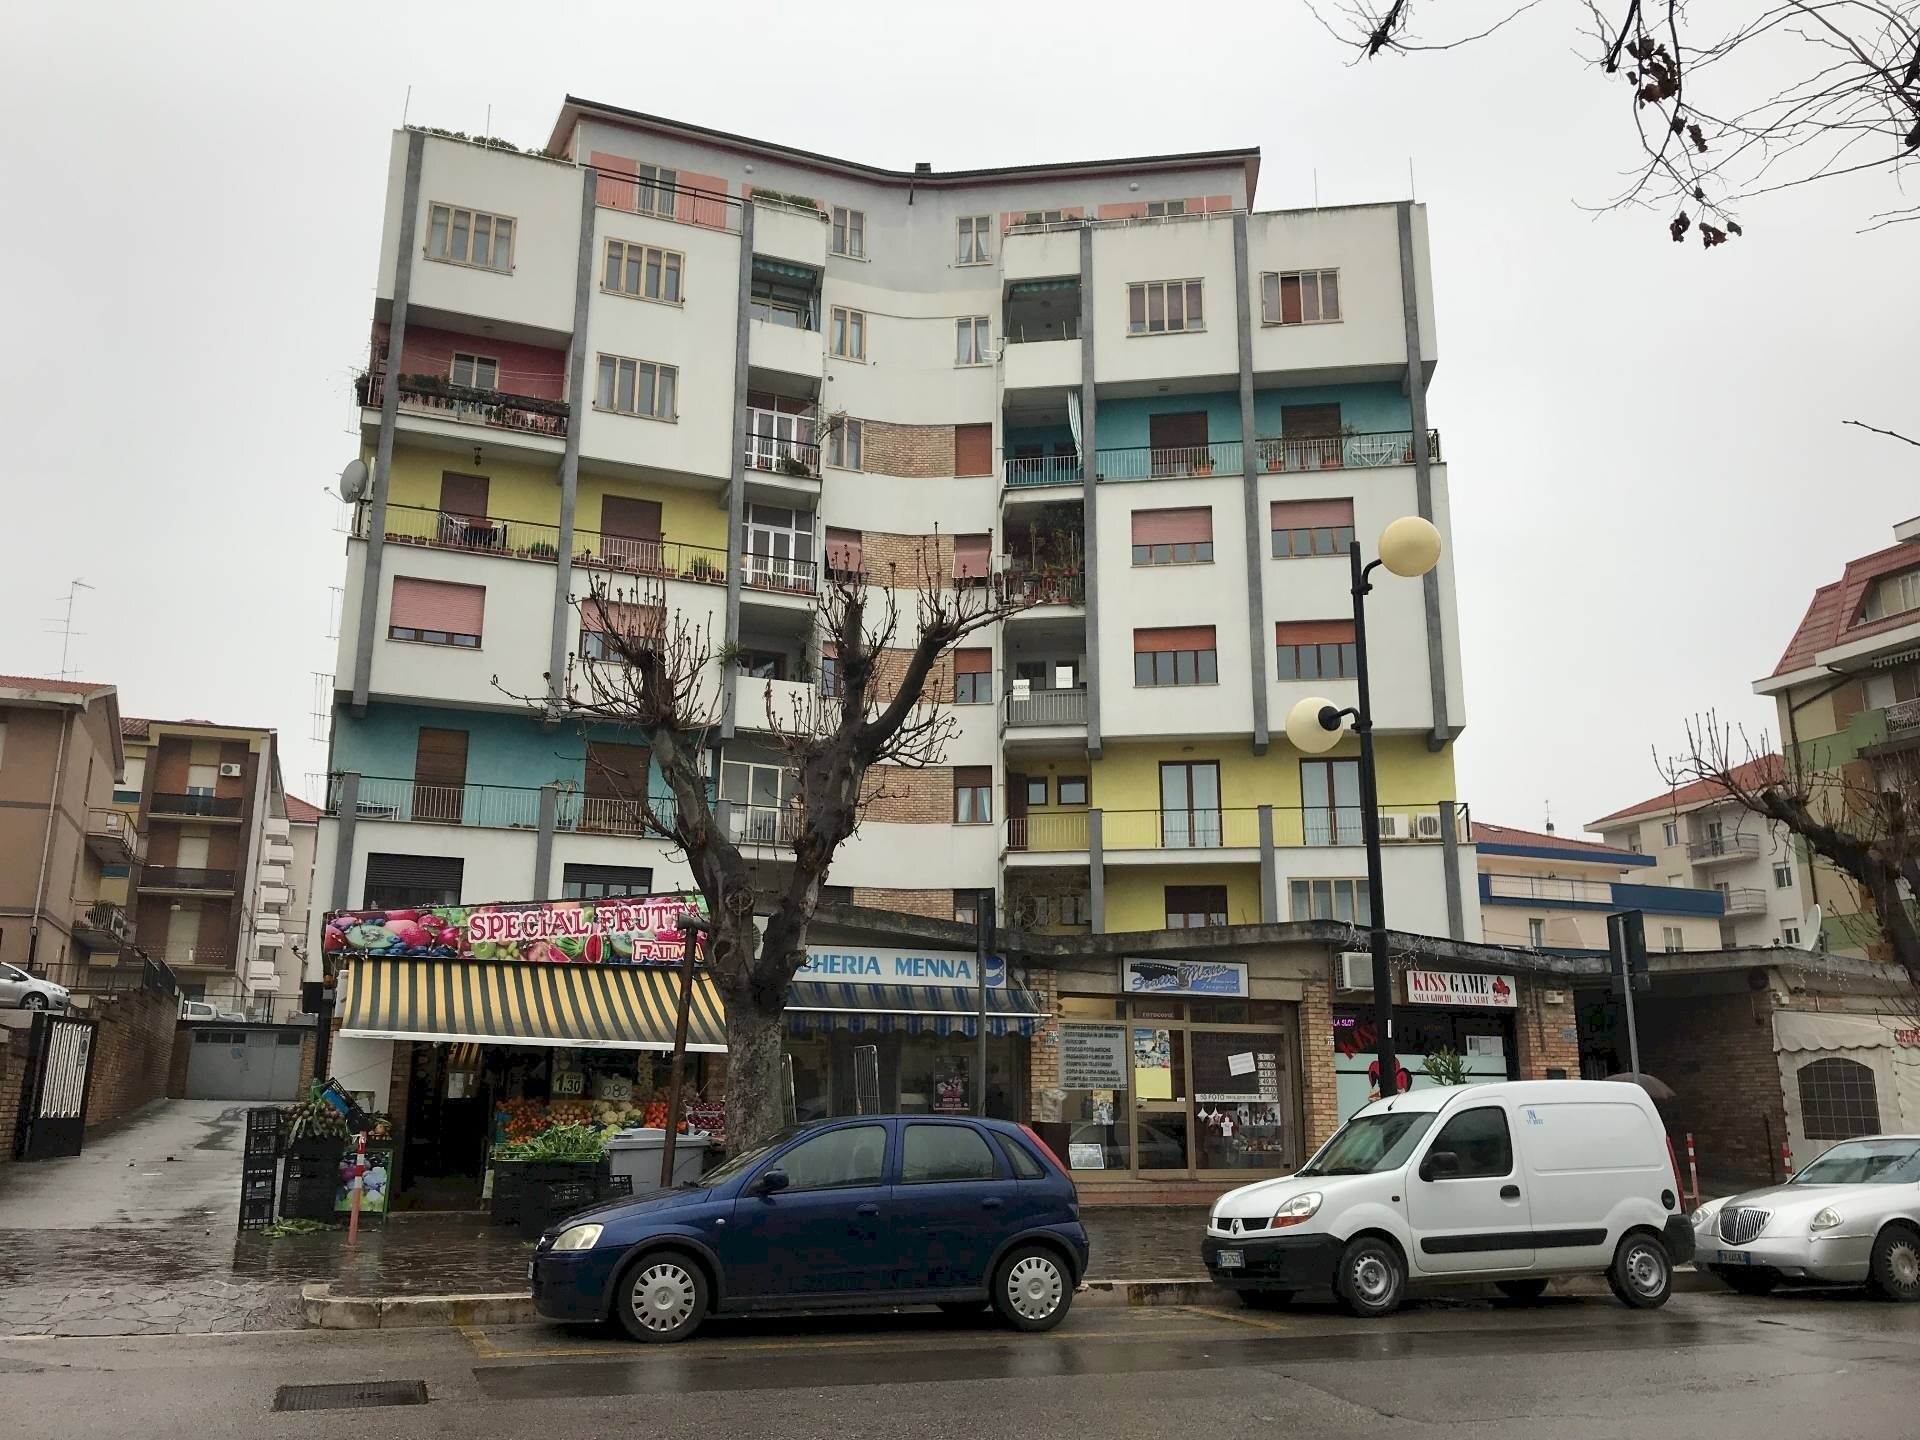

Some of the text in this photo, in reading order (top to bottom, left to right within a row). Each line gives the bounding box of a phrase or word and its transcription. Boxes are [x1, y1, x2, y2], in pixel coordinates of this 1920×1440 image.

[469, 909, 588, 942] SPECIAL
[895, 957, 971, 979] MENNA
[1413, 972, 1489, 994] KISS GAME
[555, 1074, 581, 1092] 1.30
